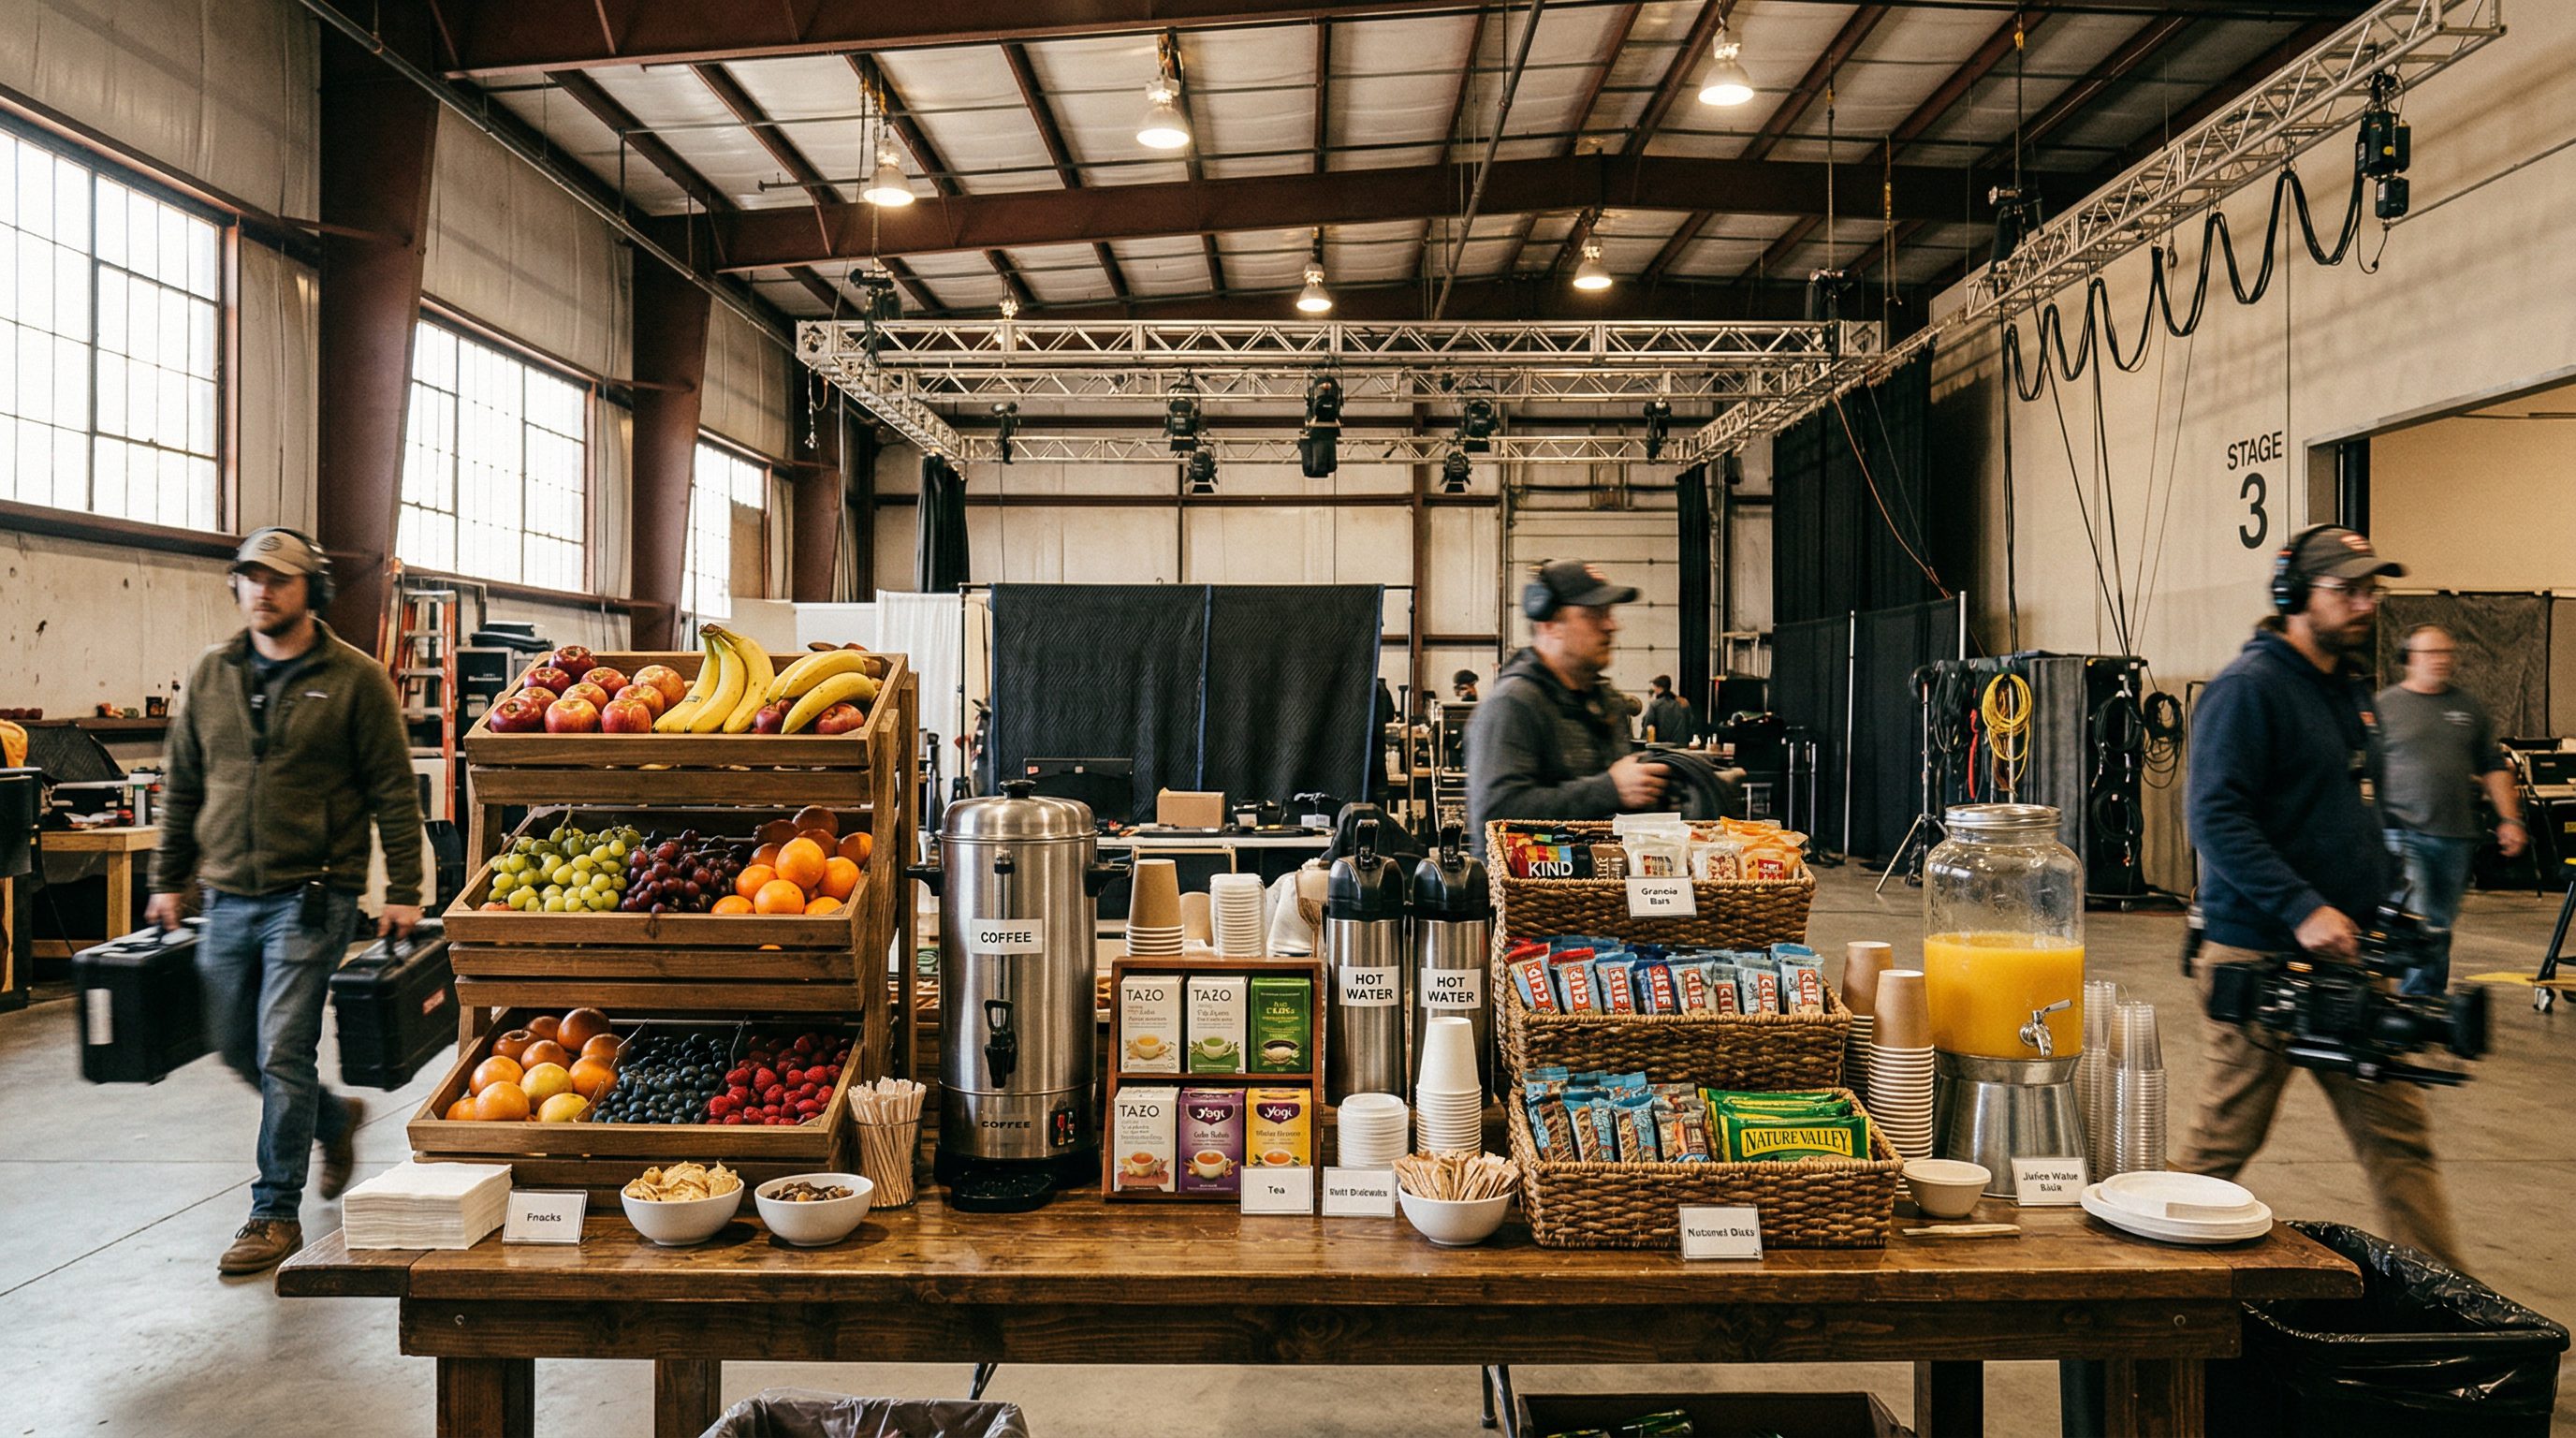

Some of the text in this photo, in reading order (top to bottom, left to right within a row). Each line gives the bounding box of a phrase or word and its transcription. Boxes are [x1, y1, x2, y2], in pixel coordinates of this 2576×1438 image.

[2227, 431, 2282, 470] STAGE
[2239, 472, 2268, 549] 3
[1529, 861, 1573, 877] KIND
[981, 932, 1032, 944] COFFEE
[1354, 974, 1383, 986] HOT
[1437, 976, 1465, 989] HOT
[1802, 973, 1818, 1002] CLIF
[1125, 989, 1164, 1001] TAZO
[1193, 989, 1232, 1002] TAZO
[1347, 989, 1393, 1001] WATER
[1427, 990, 1474, 1003] WATER
[1120, 1105, 1160, 1118] TAZO
[1745, 1130, 1849, 1153] NATURE VALLEY
[1267, 1185, 1285, 1195] Tea
[526, 1212, 562, 1222] Fnacks
